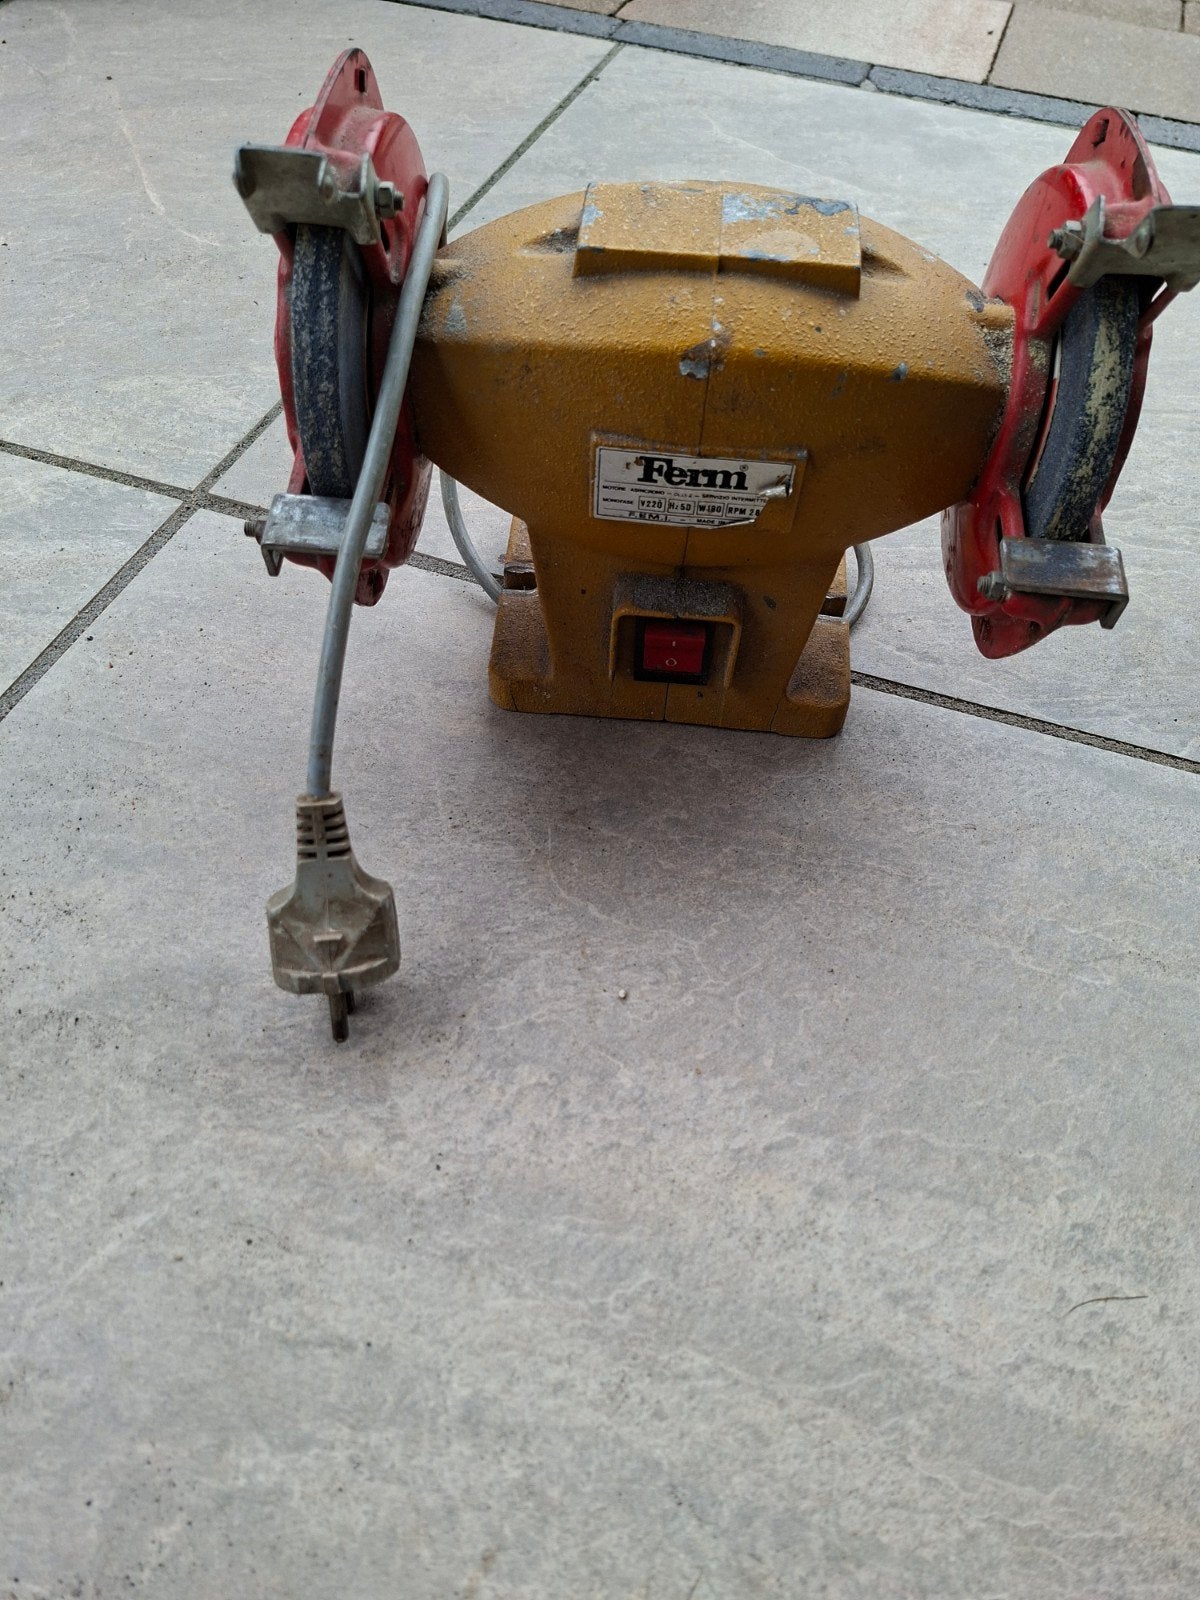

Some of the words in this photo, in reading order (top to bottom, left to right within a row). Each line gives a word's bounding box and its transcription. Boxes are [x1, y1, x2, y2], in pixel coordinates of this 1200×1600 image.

[637, 456, 748, 491] Ferm
[602, 484, 626, 492] MOTORE
[602, 497, 634, 505] MONOFASE
[727, 506, 747, 516] RPM
